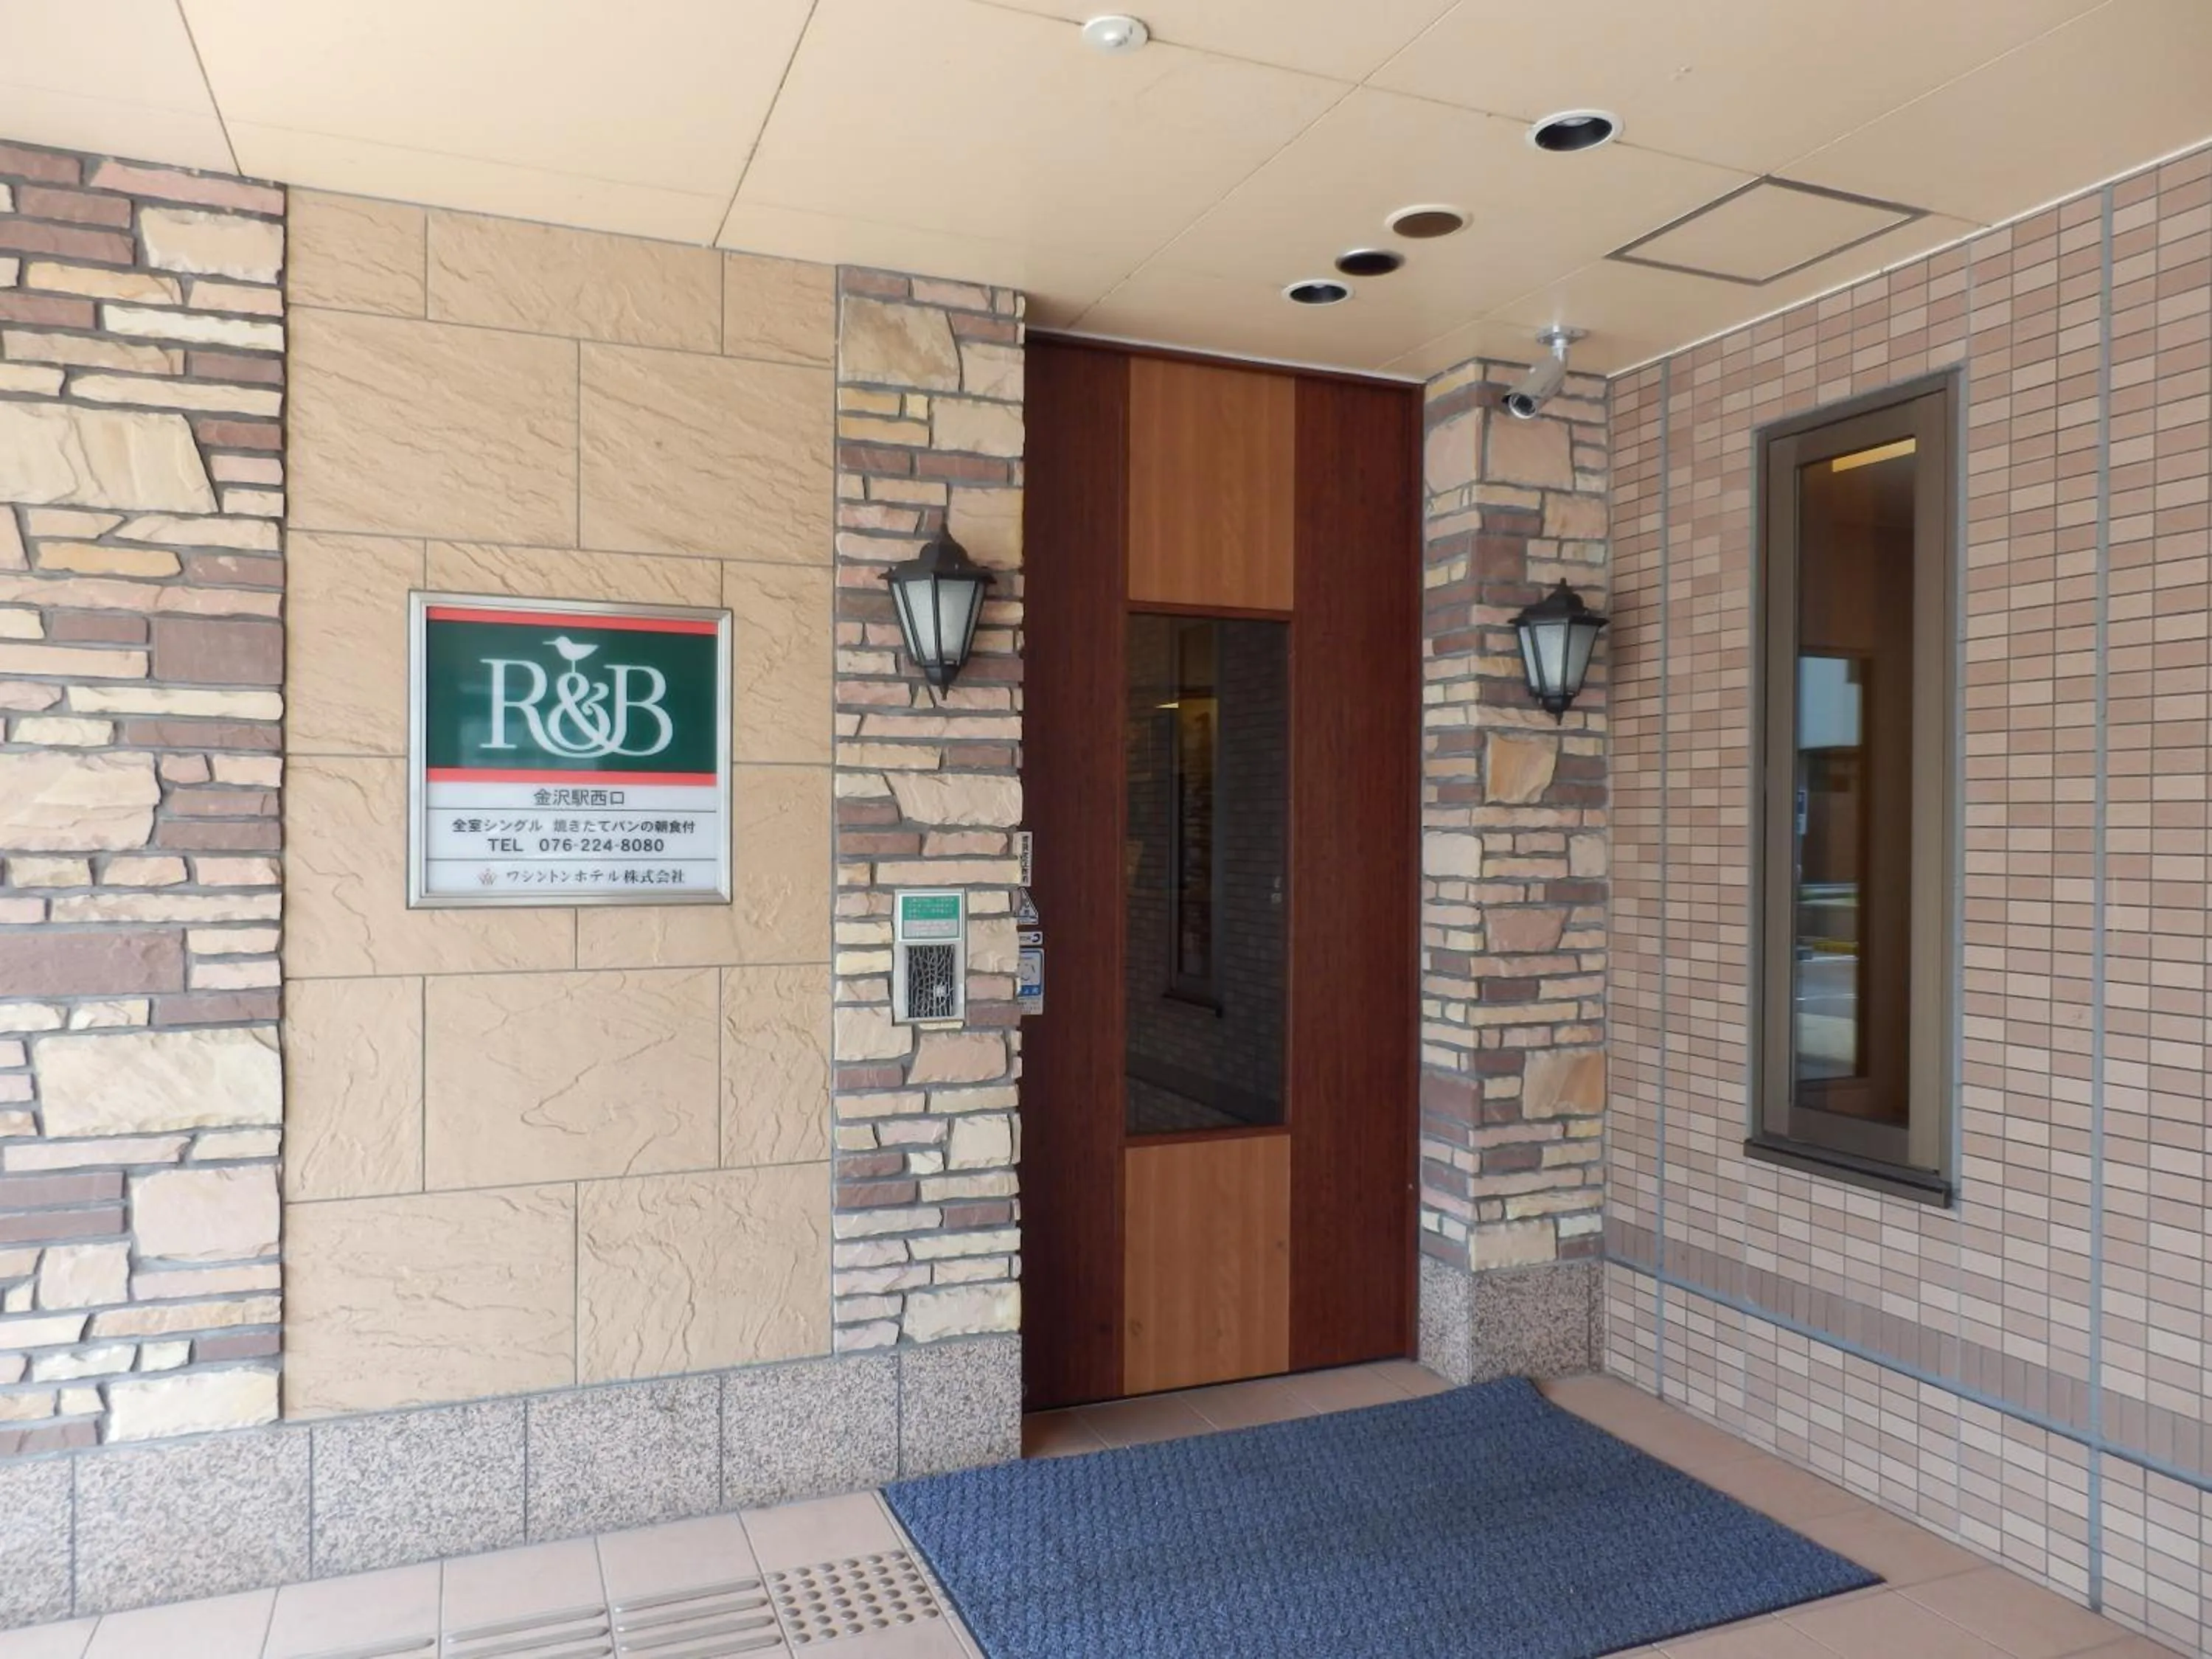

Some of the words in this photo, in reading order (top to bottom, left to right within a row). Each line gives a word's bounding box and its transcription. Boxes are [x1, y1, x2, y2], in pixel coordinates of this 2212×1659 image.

[480, 657, 674, 759] R&B
[534, 789, 625, 807] 金沢駅西口
[452, 818, 543, 833] 全室シングル
[487, 838, 524, 852] TEL
[539, 838, 664, 852] 076-224-8080
[507, 869, 685, 885] ワシントンホテル株式会社
